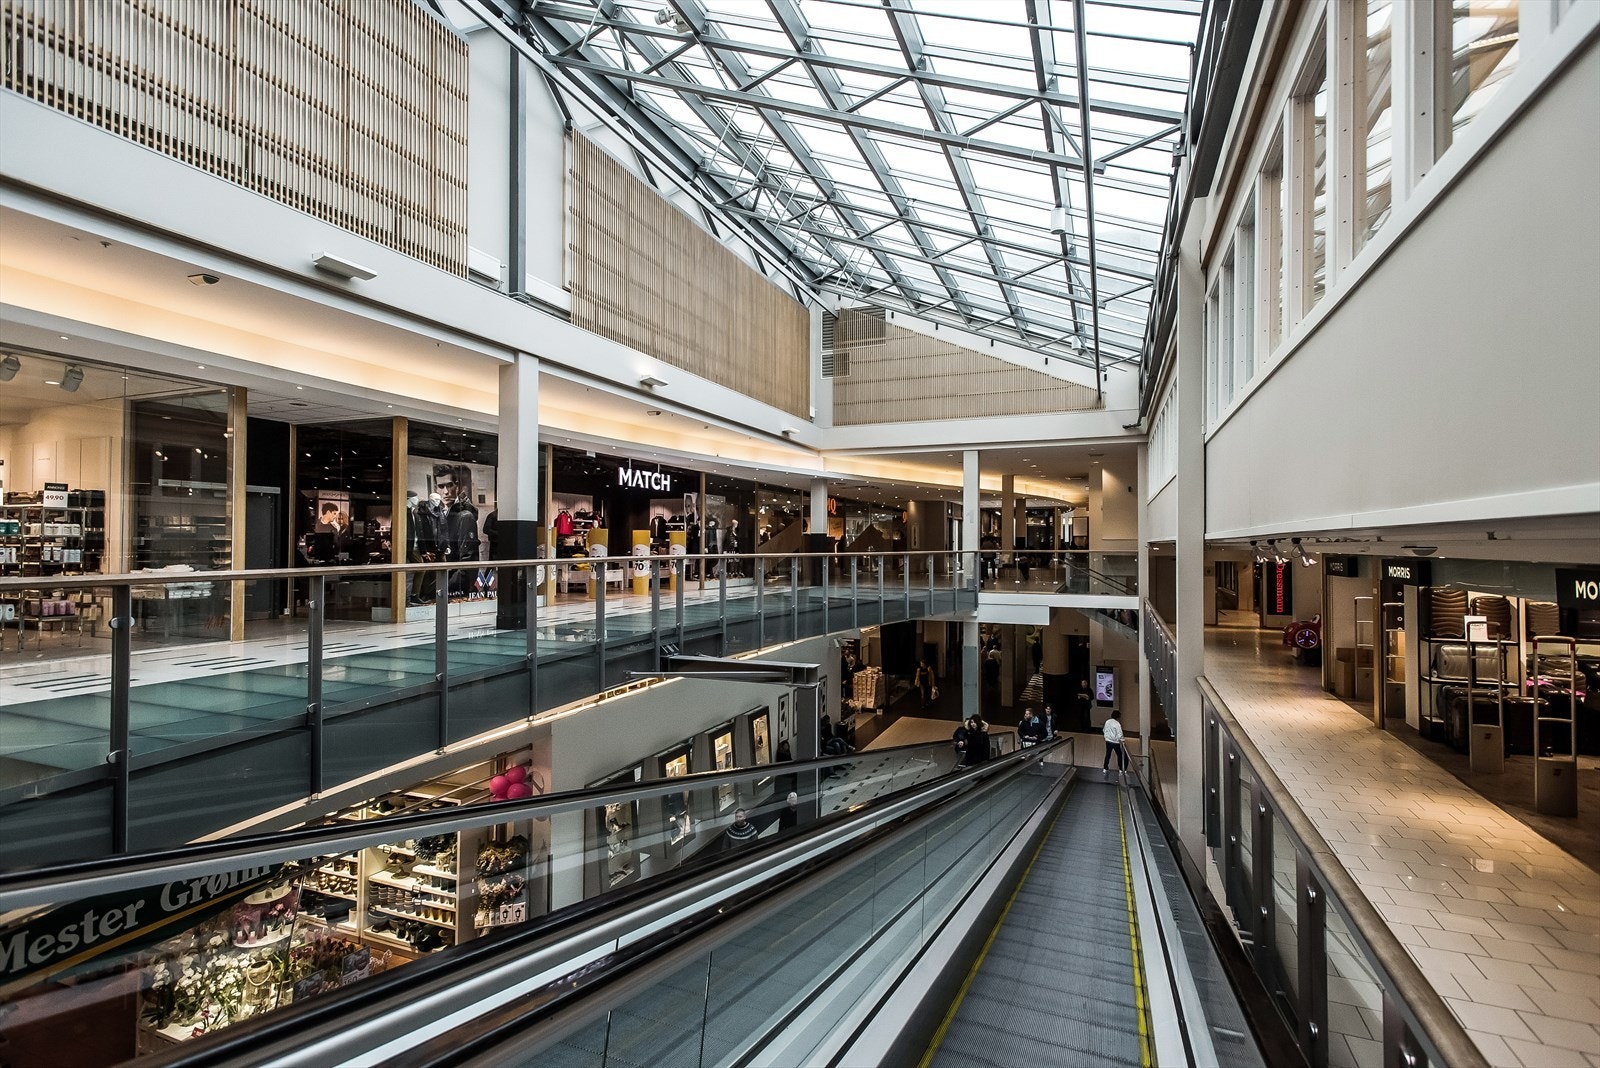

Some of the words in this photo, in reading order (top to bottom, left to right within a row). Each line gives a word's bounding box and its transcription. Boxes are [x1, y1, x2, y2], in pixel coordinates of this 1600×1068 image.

[618, 466, 670, 491] MATCH
[1388, 565, 1411, 579] MORRIS
[468, 591, 486, 600] JEAN
[1276, 563, 1286, 613] Dressmann
[1575, 580, 1600, 600] MO
[0, 899, 146, 974] Mester
